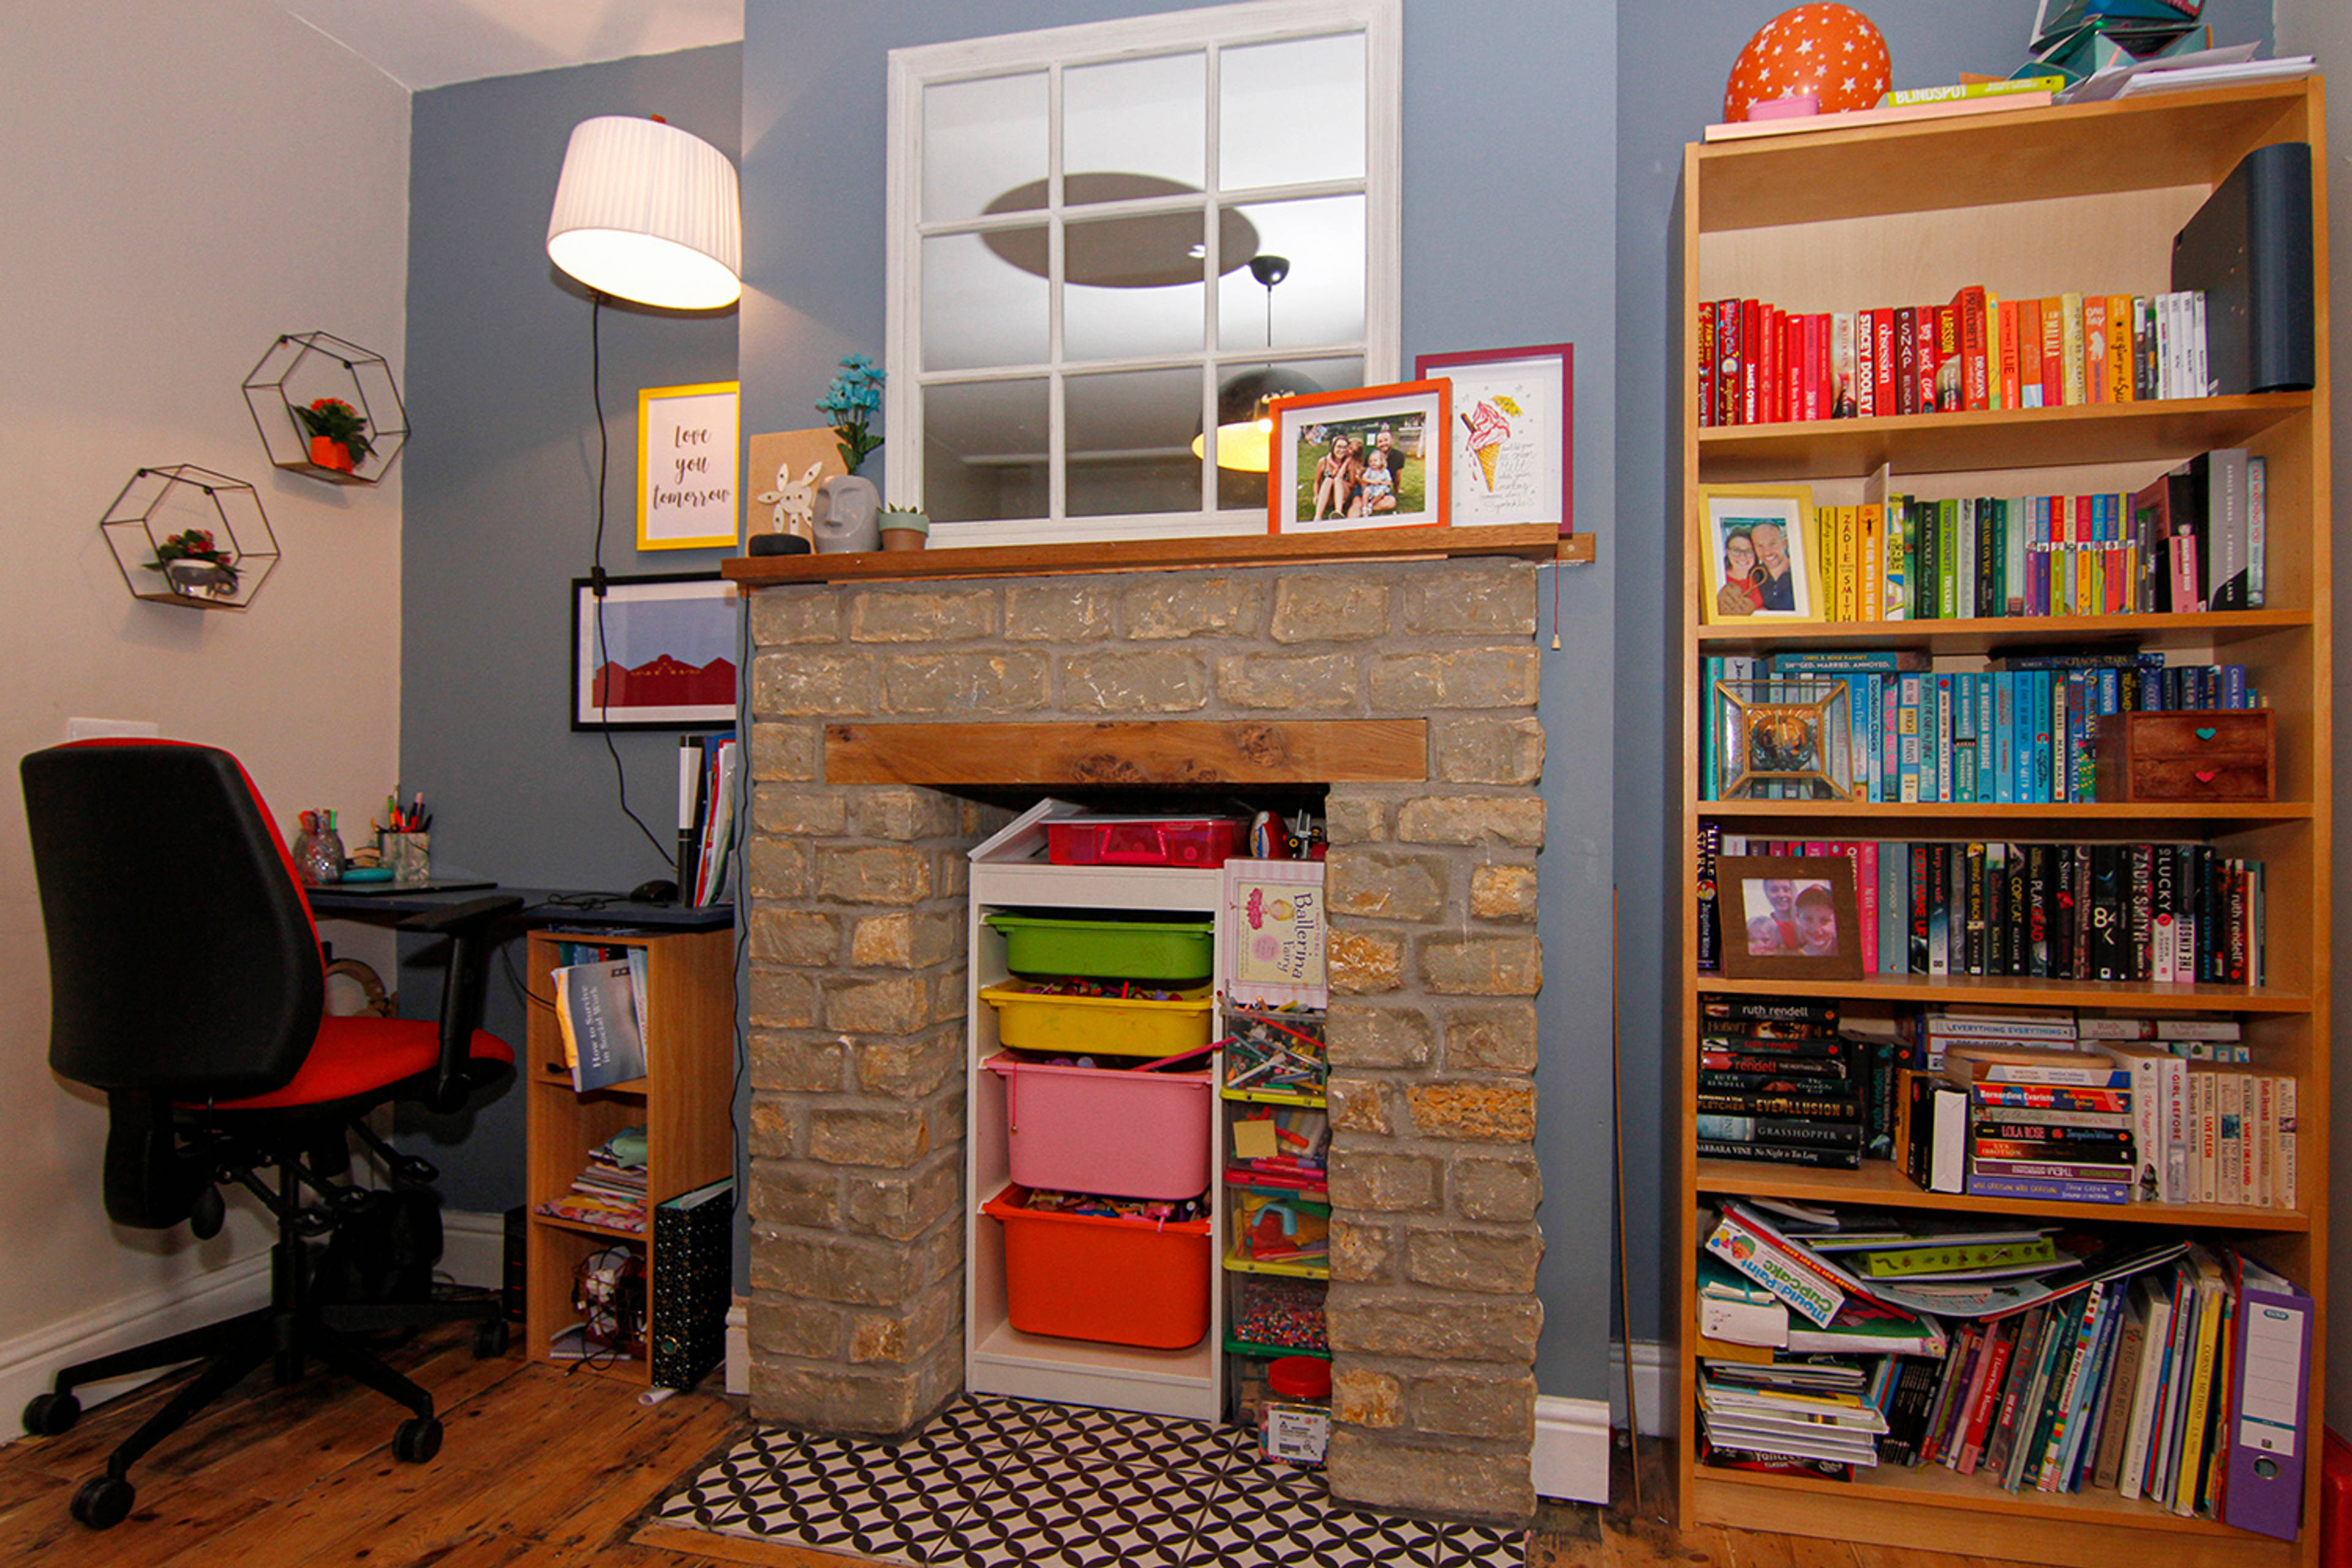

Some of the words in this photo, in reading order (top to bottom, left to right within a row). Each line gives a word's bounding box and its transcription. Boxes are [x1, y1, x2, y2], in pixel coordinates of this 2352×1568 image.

[1896, 86, 1967, 104] BLINDSPOT
[1941, 310, 1954, 353] LARSSON
[1966, 292, 1977, 350] PRATCHETT
[1860, 314, 1872, 358] STACEY
[1901, 323, 1912, 368] SNAP
[2044, 320, 2059, 358] MALALA
[1879, 323, 1893, 383] obsession
[2004, 356, 2014, 374] LIE
[1861, 362, 1872, 410] DOOLEY
[1975, 356, 1985, 399] DRAGONS
[674, 456, 709, 484] you
[2252, 467, 2260, 481] AM
[654, 484, 729, 510] tomorrow
[2252, 483, 2260, 525] WATCHING
[1842, 514, 1851, 562] ZADIE
[2252, 528, 2260, 544] YOU
[1983, 547, 1991, 558] ON
[1842, 576, 1852, 622] SMITH
[1981, 684, 1989, 693] AN
[2103, 674, 2114, 712] Natives
[2230, 668, 2239, 693] CHINA
[1885, 690, 1895, 707] HER
[1885, 709, 1896, 731] NAME
[1980, 695, 1990, 731] AMERICAN
[1885, 734, 1896, 752] WAS
[1980, 734, 1990, 770] MARRIAGE
[1885, 754, 1896, 775] ROSE
[1697, 832, 1706, 873] STARS
[1708, 829, 1716, 876] LITTLE
[1915, 848, 1926, 881] DON'T
[1972, 857, 1981, 882] BRING
[2059, 861, 2070, 891] Sister
[2133, 853, 2149, 894] ZADIE
[1972, 883, 1981, 896] ME
[2030, 880, 2043, 907] PLAY
[2158, 858, 2171, 911] LUCKY
[1915, 884, 1926, 917] WAKE
[1972, 898, 1981, 920] BACK
[2231, 894, 2242, 918] ruth
[1915, 920, 1927, 937] UP
[2031, 908, 2043, 941] DEAD
[2133, 895, 2149, 941] SMITH
[1292, 893, 1314, 979] Ballerina
[2231, 921, 2244, 961] rendell
[1277, 940, 1294, 973] Fairy
[2179, 956, 2192, 971] THE
[1742, 1005, 1766, 1016] ruth
[1769, 1006, 1809, 1017] rendell
[589, 1027, 596, 1038] to
[2008, 1027, 2064, 1035] EVERYTHING
[592, 1041, 601, 1068] How
[1735, 1061, 1777, 1072] rendell
[1757, 1099, 1780, 1113] EVE
[1980, 1090, 2022, 1100] Bernardine
[2024, 1093, 2055, 1102] Evaristo
[1757, 1128, 1838, 1140] GRASSHOPPER
[2002, 1126, 2022, 1138] LOLA
[2024, 1126, 2045, 1139] ROSE
[2204, 1116, 2213, 1133] LIVE
[1733, 1145, 1753, 1155] VINE
[1804, 1152, 1819, 1161] Long
[2048, 1168, 2073, 1177] THEM
[1763, 1259, 1833, 1313] Cupcake
[1781, 1285, 1828, 1324] mould
[2123, 1345, 2136, 1363] VEG
[2199, 1343, 2212, 1381] CORNET
[2117, 1377, 2132, 1397] ONE
[2114, 1398, 2130, 1417] BED
[2195, 1384, 2207, 1419] METHOD
